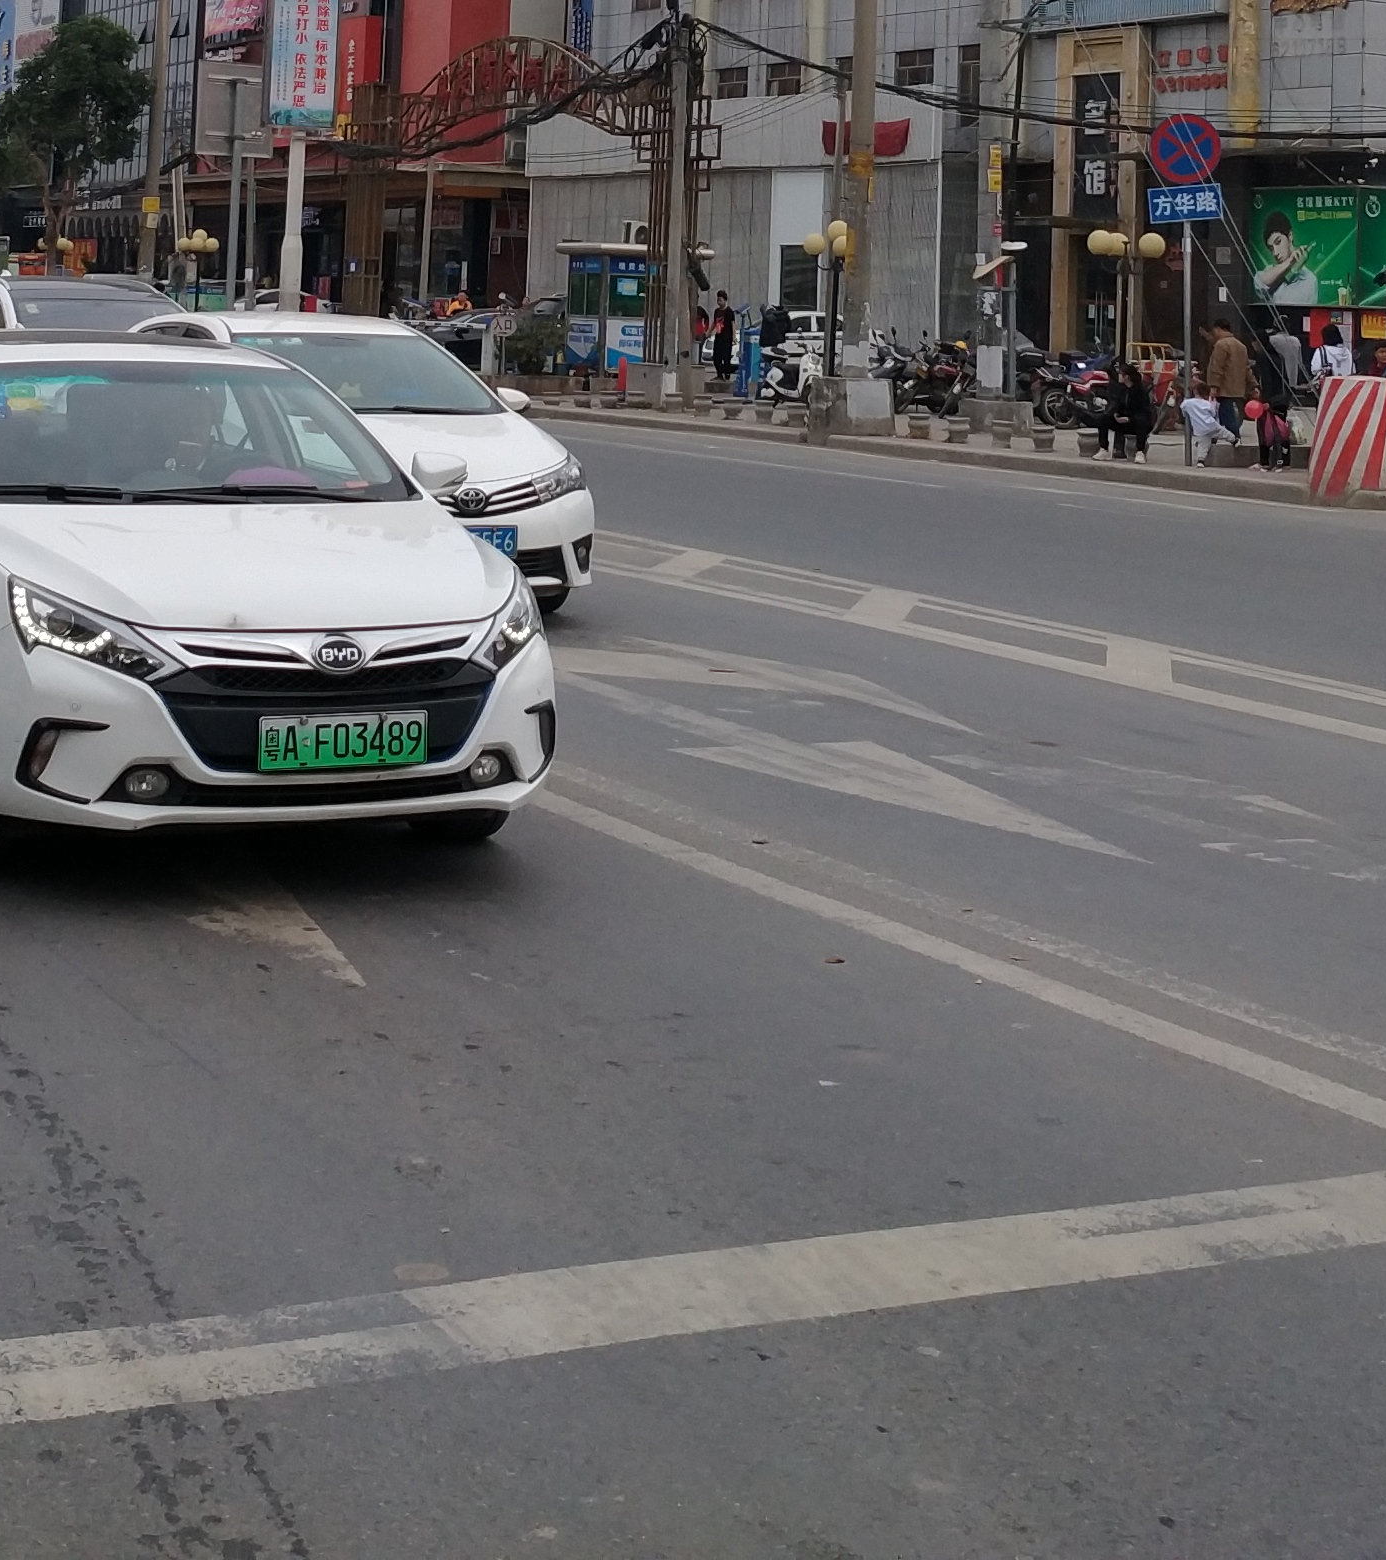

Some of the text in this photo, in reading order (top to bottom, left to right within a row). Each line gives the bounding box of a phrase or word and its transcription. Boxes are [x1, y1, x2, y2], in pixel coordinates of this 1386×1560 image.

[1152, 190, 1218, 217] 方华路
[494, 317, 513, 331] 入口
[321, 646, 359, 662] BYD
